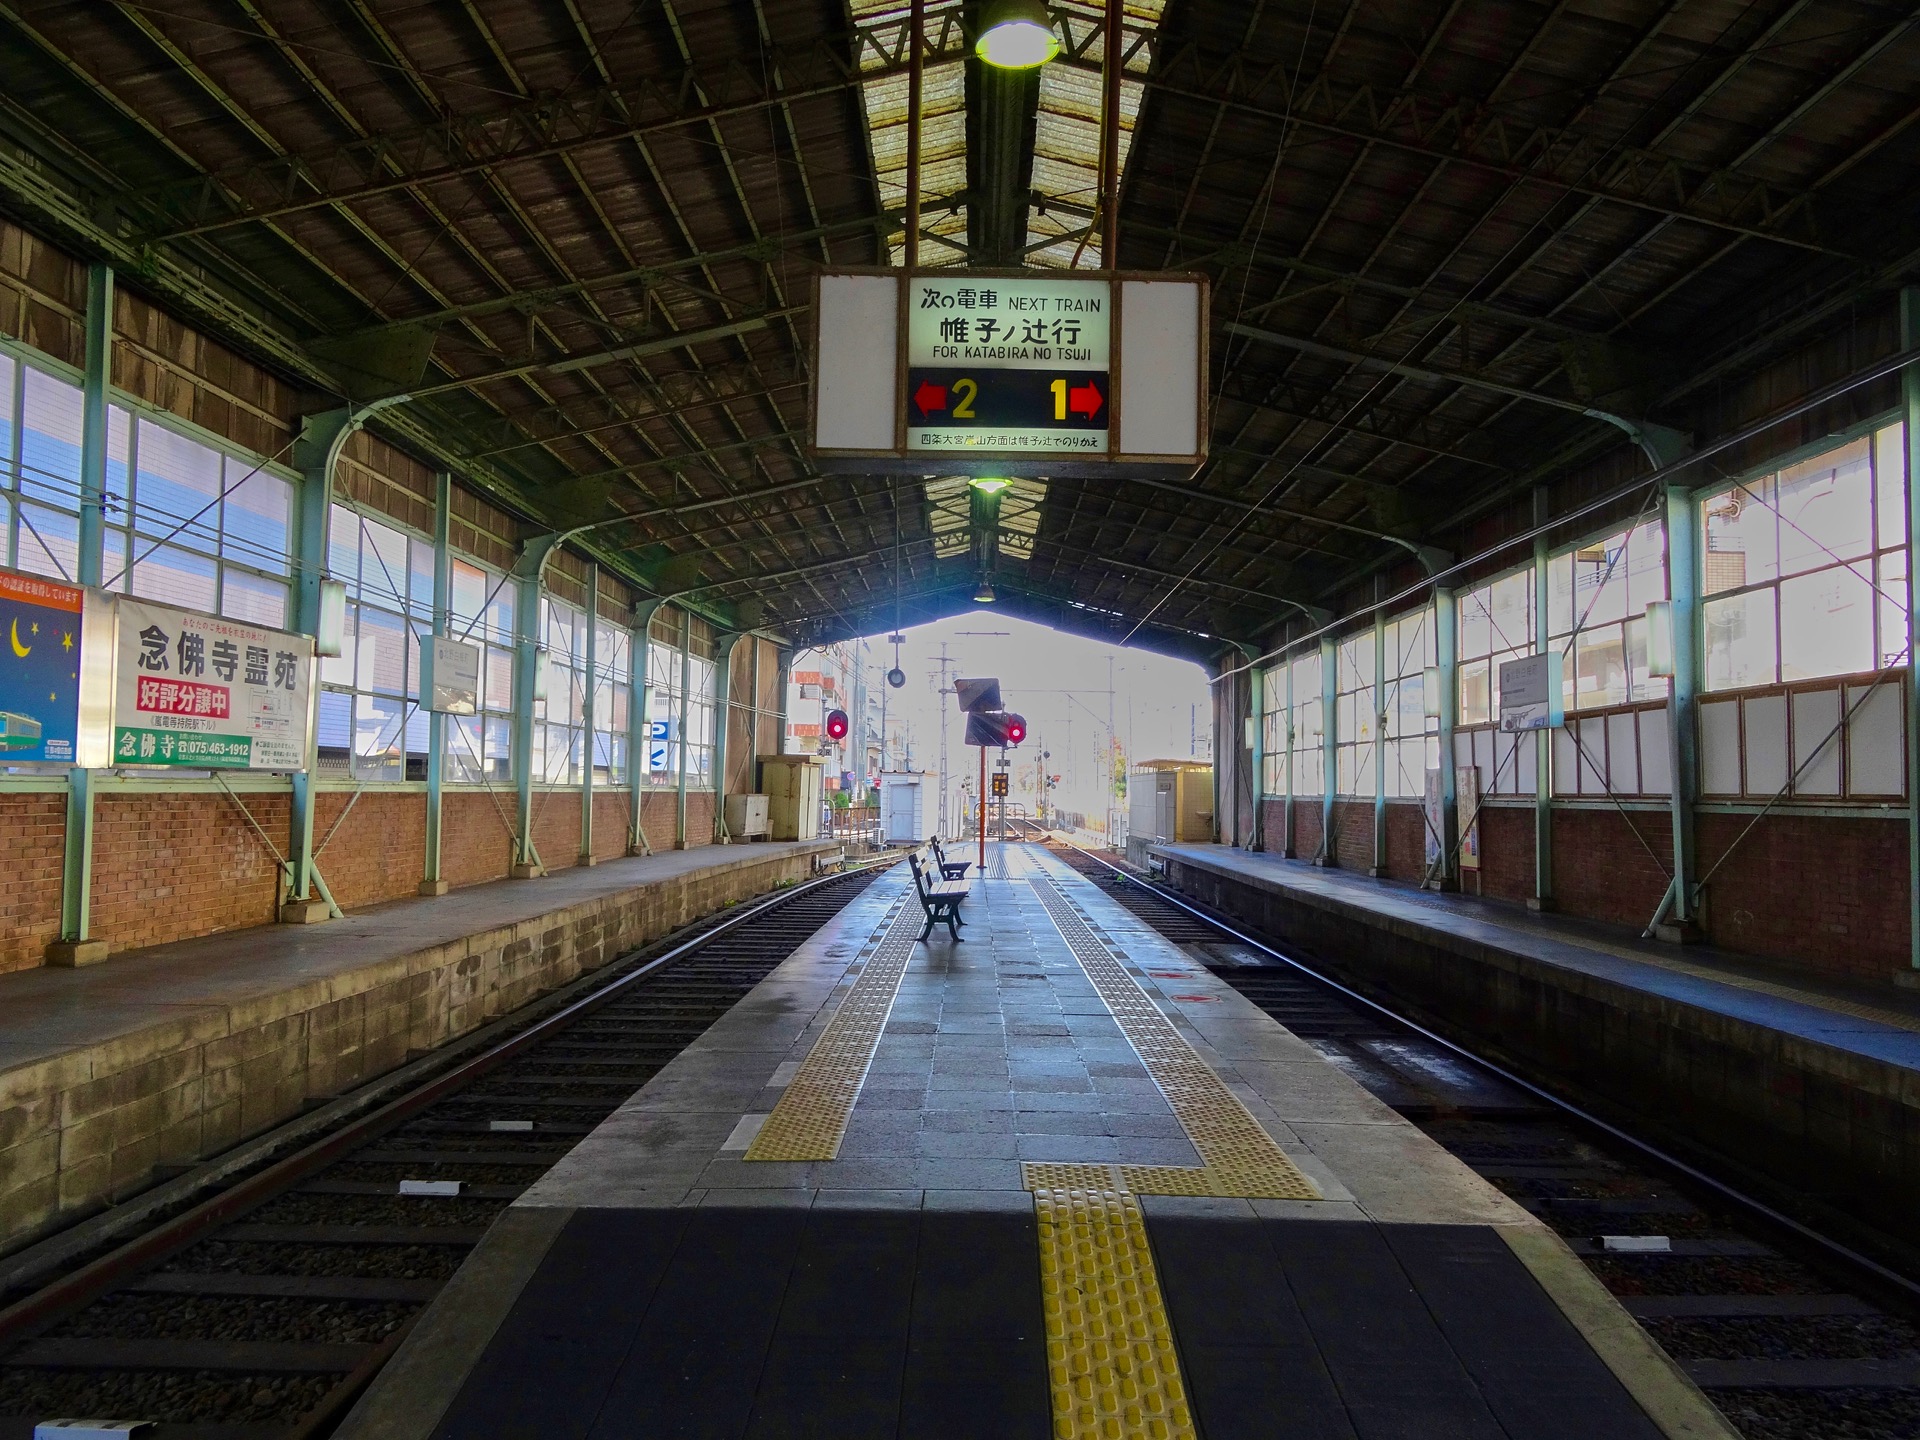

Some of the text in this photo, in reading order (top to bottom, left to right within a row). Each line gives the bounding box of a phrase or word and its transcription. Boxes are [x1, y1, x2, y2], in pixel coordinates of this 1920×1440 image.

[920, 288, 998, 309] 次の電車
[1008, 297, 1101, 312] NEXT TRAIN
[940, 317, 1082, 345] 帷子ノ辻行
[933, 345, 1091, 361] FOR KATABIRA NO TSUJI
[951, 378, 978, 418] 2
[1050, 379, 1067, 420] 1
[138, 624, 298, 691] 念佛寺霊苑
[140, 682, 228, 716] 好評分譲中
[118, 731, 176, 759] 念佛寺
